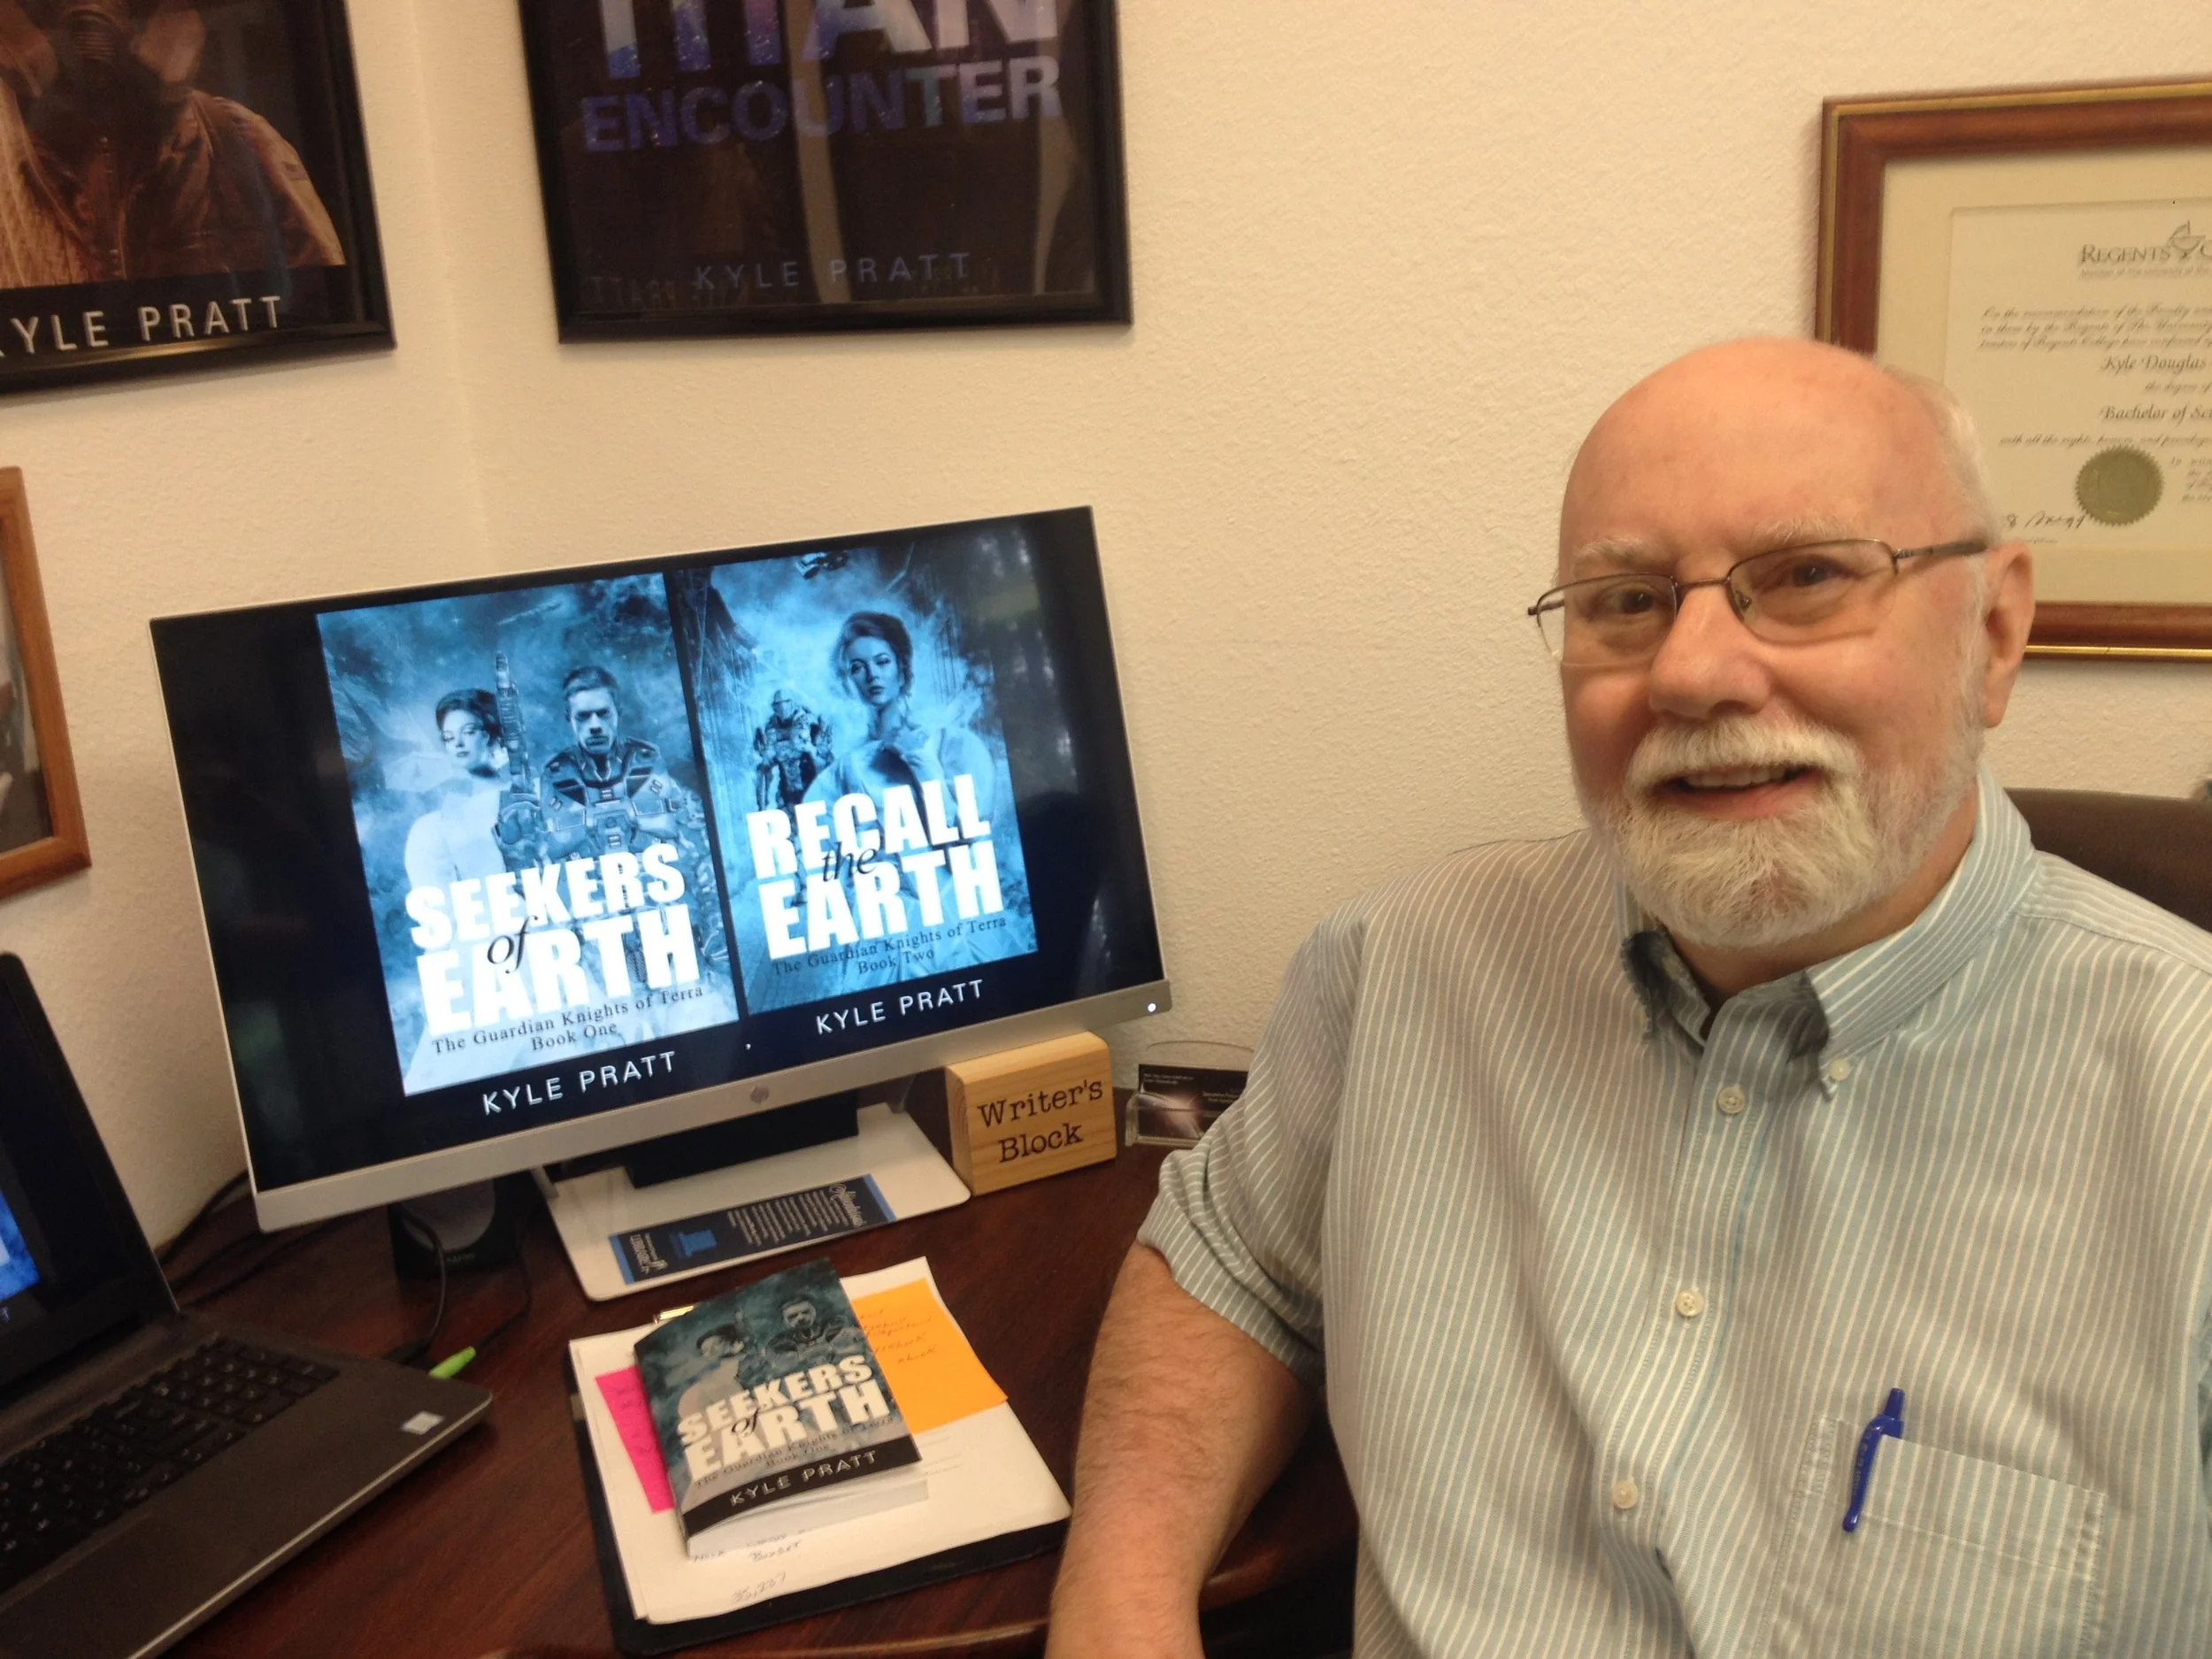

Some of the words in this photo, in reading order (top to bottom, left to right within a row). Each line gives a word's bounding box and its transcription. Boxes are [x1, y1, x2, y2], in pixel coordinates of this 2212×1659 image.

[580, 56, 1060, 152] ENCOUNTER
[696, 261, 799, 289] KYLE
[831, 253, 970, 282] PRATT
[2081, 244, 2170, 263] REGENTS
[0, 311, 108, 356] YLE
[139, 295, 281, 342] PRATT
[2101, 356, 2137, 374] Kyle
[2140, 354, 2206, 374] Douglas
[2101, 403, 2166, 419] Bachelor
[2172, 404, 2187, 426] of
[746, 773, 991, 879] RECALL
[821, 841, 878, 882] the
[405, 843, 686, 951] SEEKERS
[758, 841, 1003, 960] EARTH
[417, 904, 700, 1037] EARTH
[487, 915, 538, 973] of
[773, 960, 800, 975] The
[807, 944, 879, 968] Guardian
[885, 930, 942, 956] Knights
[948, 920, 964, 937] of
[967, 917, 1007, 935] Terra
[858, 956, 897, 974] Book
[902, 949, 935, 965] Two
[432, 1038, 465, 1055] The
[473, 1018, 555, 1045] Guardian
[561, 1002, 630, 1027] Knights
[635, 991, 654, 1010] of
[658, 986, 703, 1005] Terra
[816, 1002, 886, 1035] KYLE
[899, 979, 983, 1018] PRATT
[531, 1033, 577, 1051] Book
[584, 1023, 618, 1039] One
[482, 1076, 563, 1115] KYLE
[580, 1050, 676, 1092] PRATT
[978, 1079, 1104, 1128] Writer's
[999, 1123, 1084, 1164] Block
[676, 1355, 873, 1444] SEEKERS
[682, 1379, 890, 1475] EARTH
[732, 1410, 763, 1437] of
[729, 1475, 791, 1507] KYLE
[802, 1450, 877, 1483] PRATT
